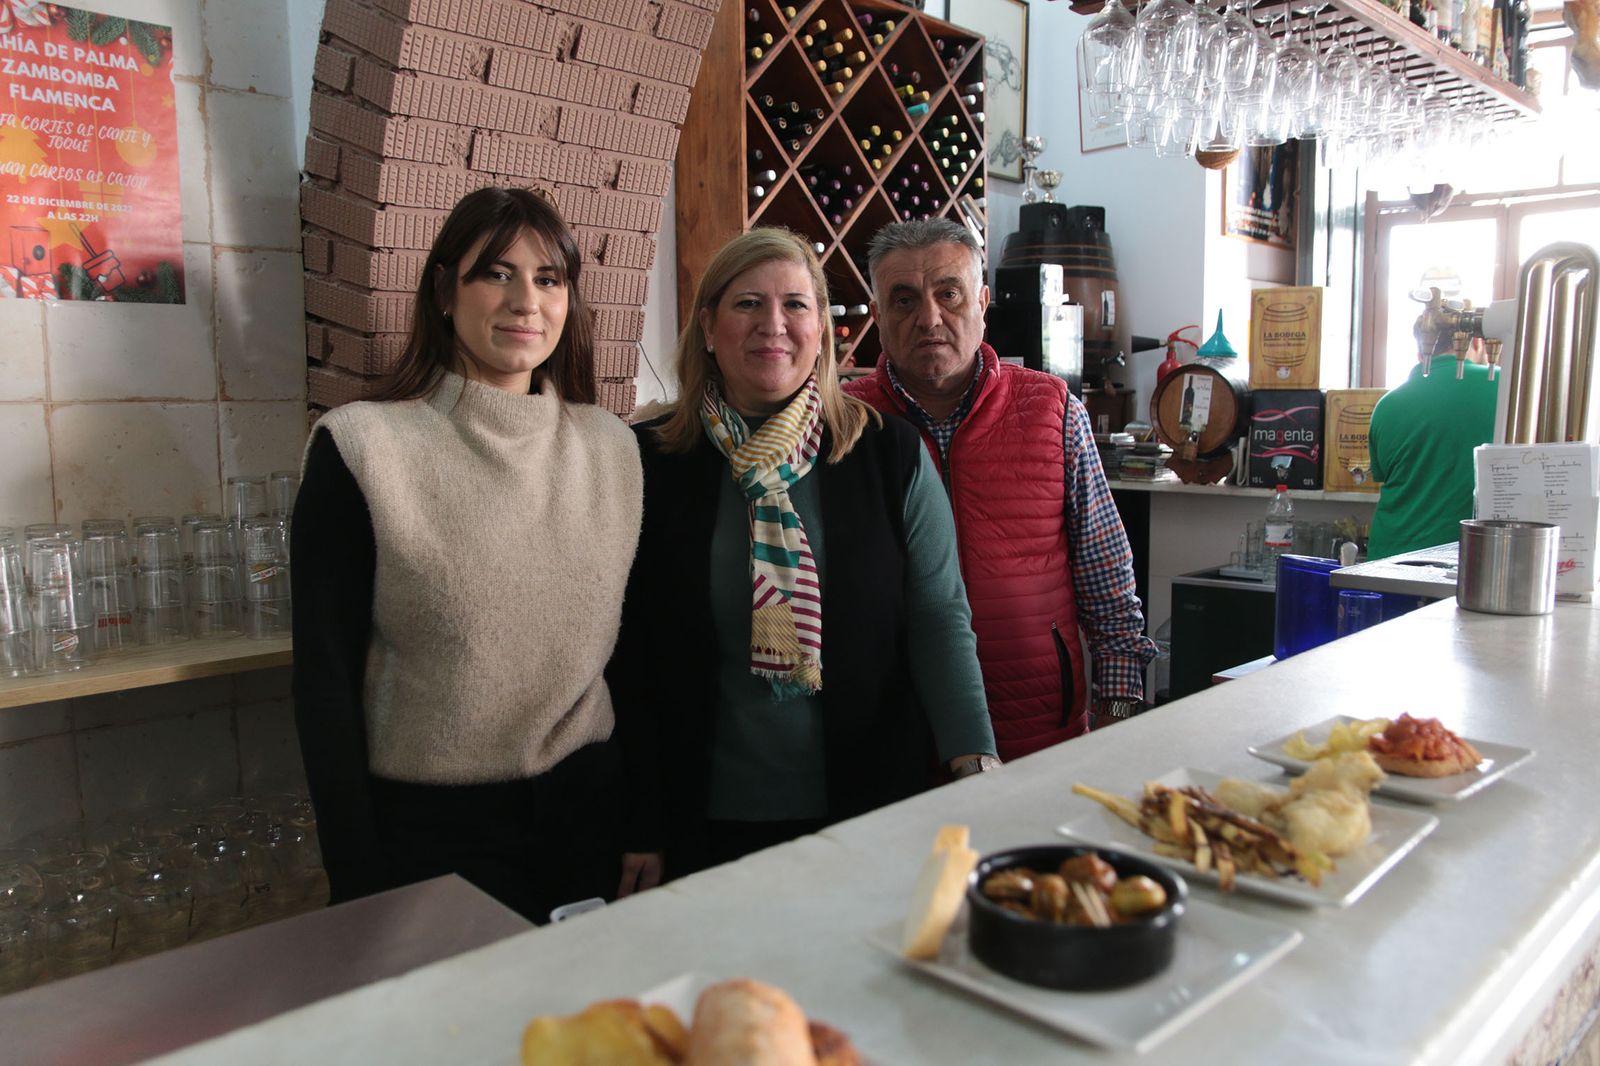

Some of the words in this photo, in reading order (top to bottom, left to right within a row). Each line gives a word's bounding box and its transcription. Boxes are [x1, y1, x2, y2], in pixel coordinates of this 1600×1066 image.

[0, 32, 39, 55] HÍA
[44, 41, 69, 60] DE
[73, 47, 139, 72] PALMA
[2, 58, 120, 91] ZAMBOMBA
[9, 83, 116, 112] FLAMENCA
[6, 194, 20, 204] 22
[22, 195, 37, 206] DE
[38, 197, 95, 210] DICIEMBRE
[96, 202, 111, 212] DE
[47, 211, 56, 220] A
[57, 212, 77, 222] LAS
[79, 214, 100, 224] 22H
[1254, 428, 1314, 445] magenta
